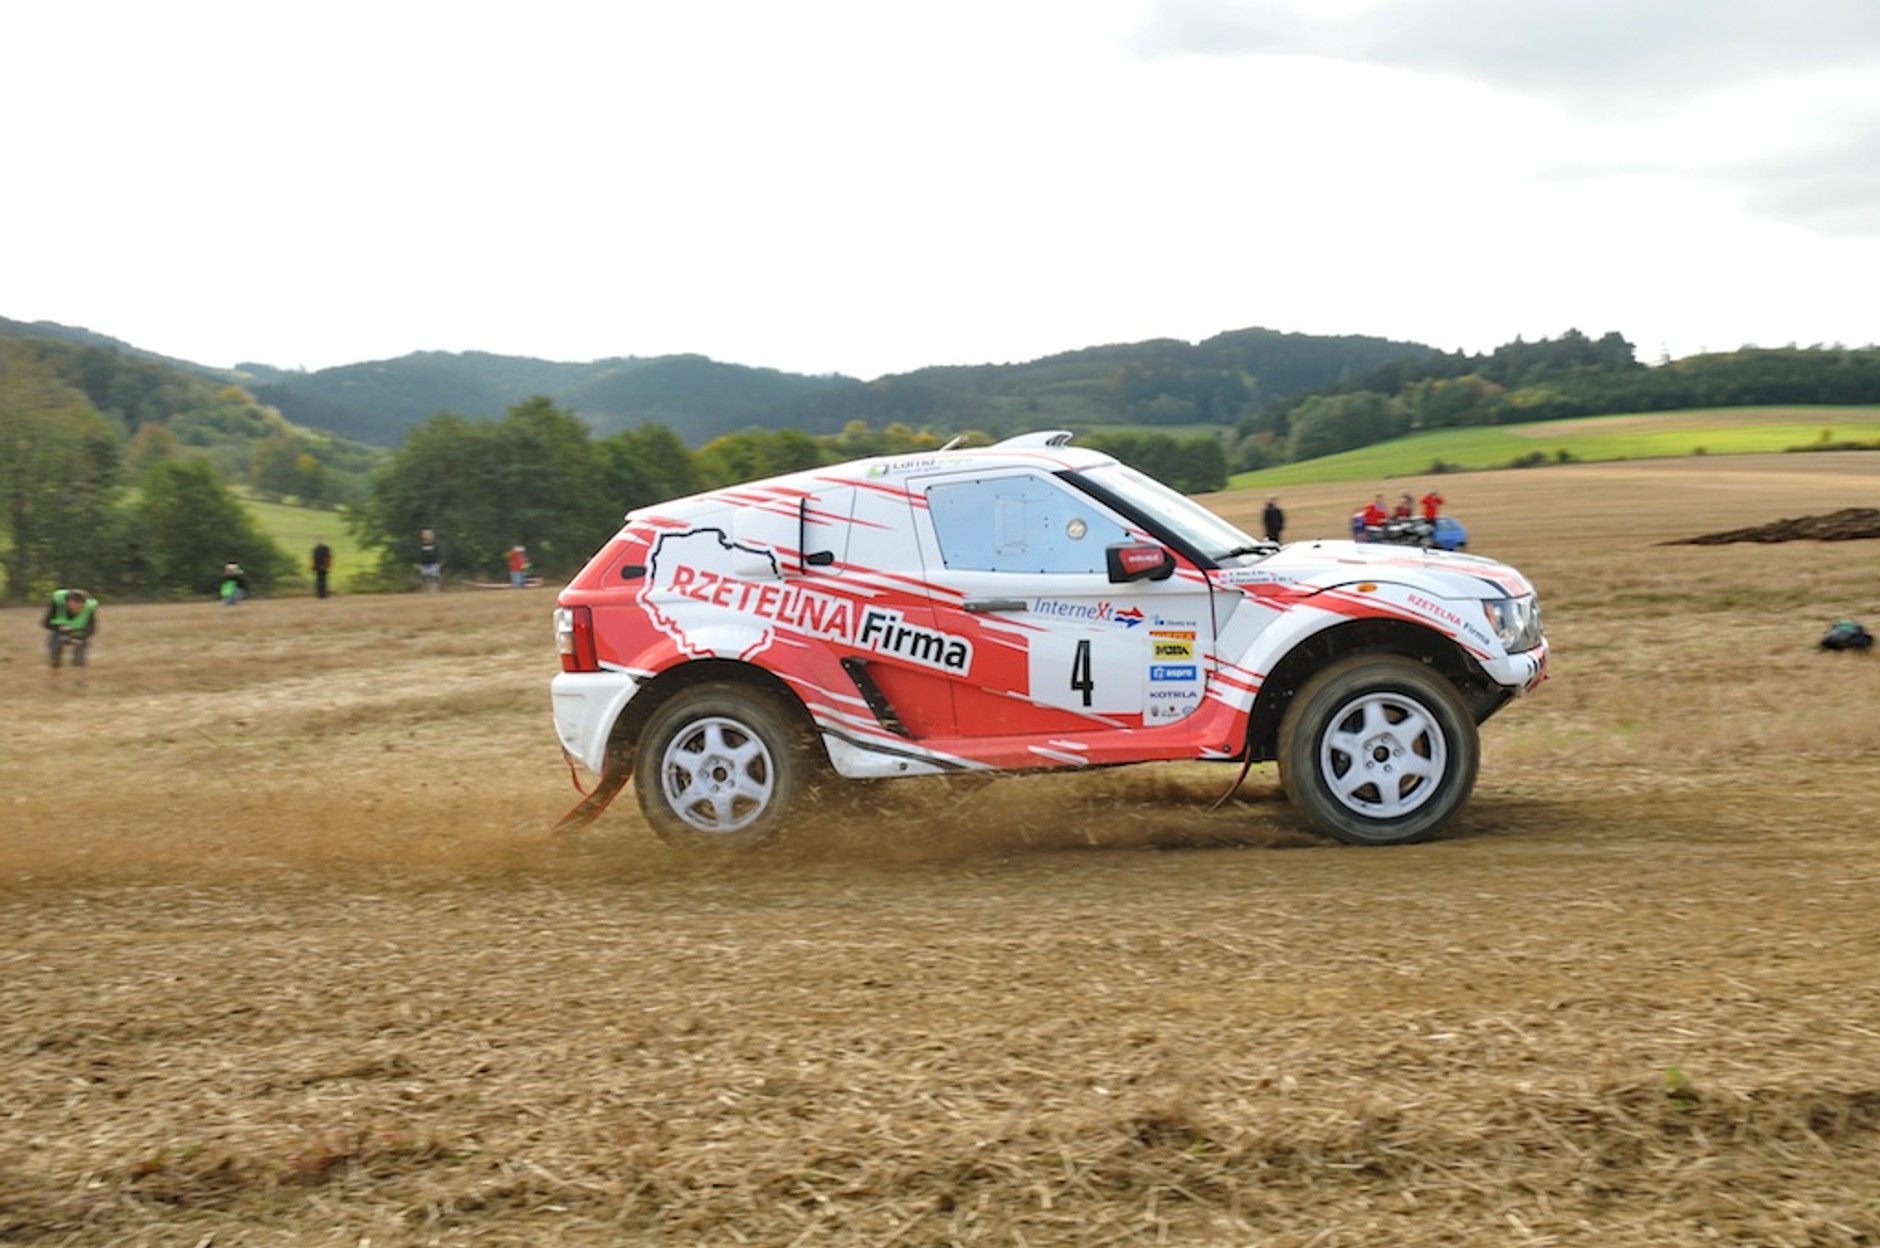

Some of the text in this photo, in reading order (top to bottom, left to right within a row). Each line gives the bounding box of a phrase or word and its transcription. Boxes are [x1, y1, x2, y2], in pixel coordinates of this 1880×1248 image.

[667, 565, 968, 670] RZETELNA Firma
[1406, 594, 1491, 645] RZETELNA Firma
[1070, 639, 1094, 707] 4
[1150, 690, 1197, 698] KOTRLA
